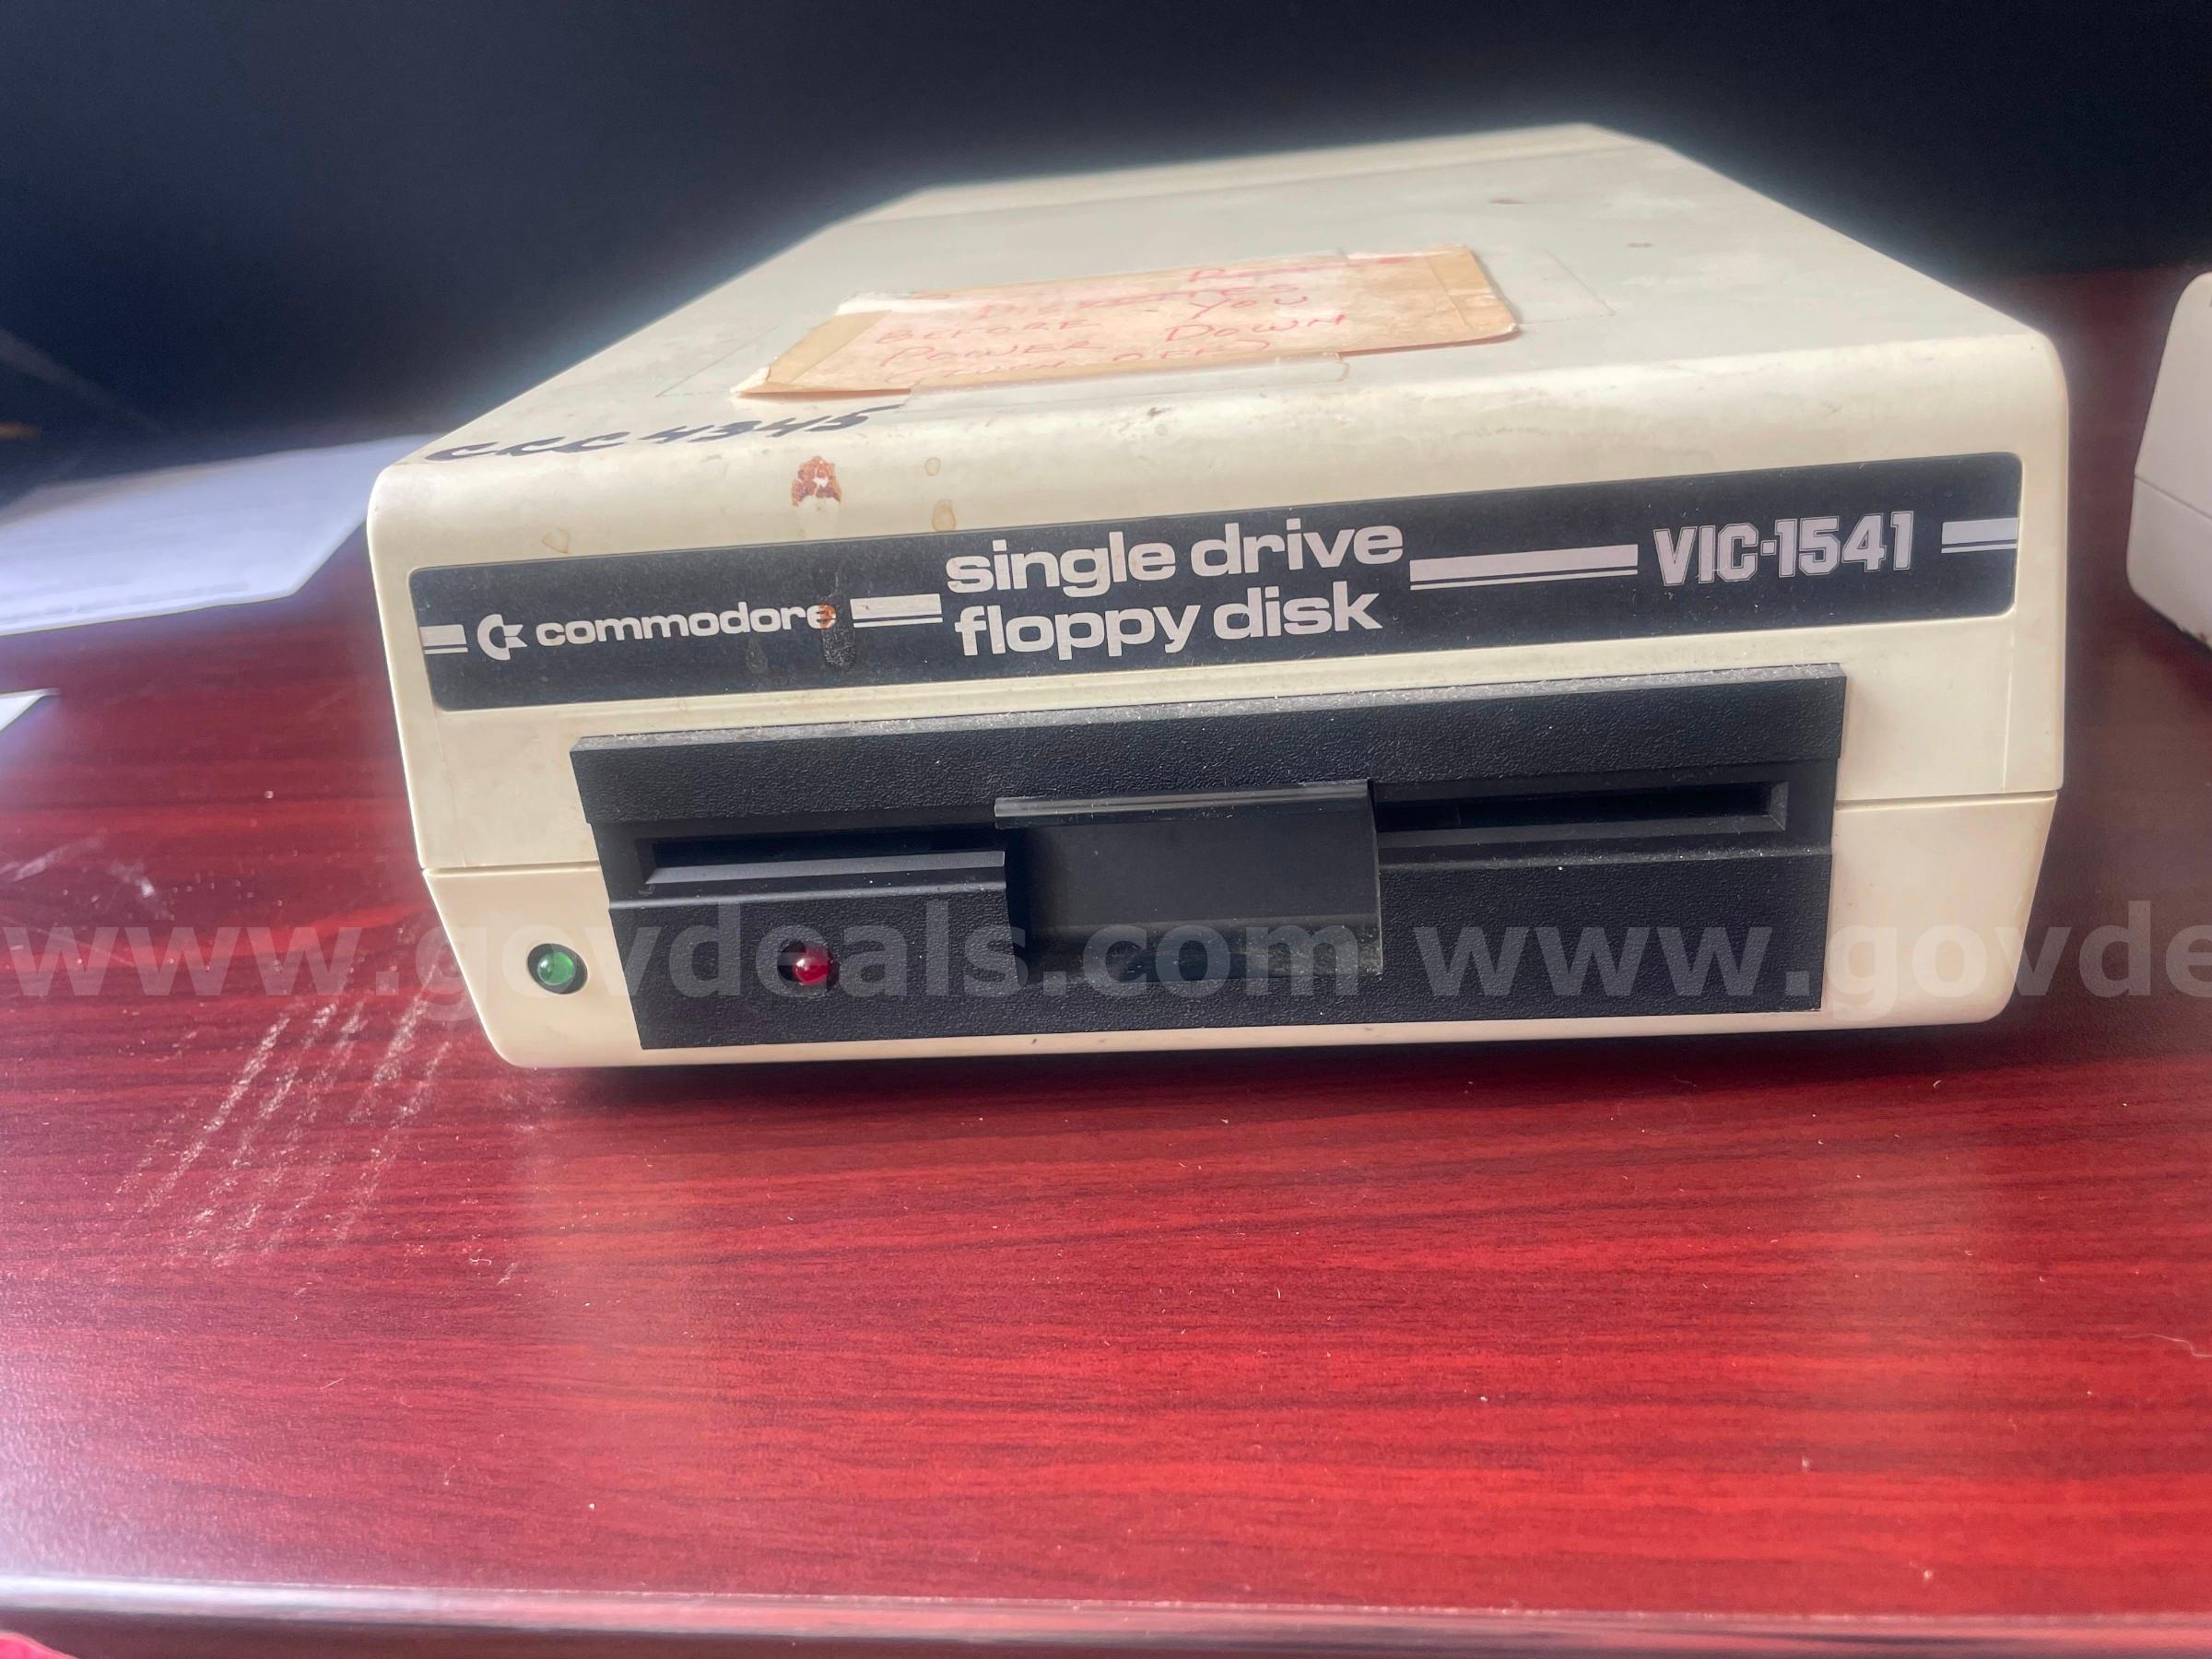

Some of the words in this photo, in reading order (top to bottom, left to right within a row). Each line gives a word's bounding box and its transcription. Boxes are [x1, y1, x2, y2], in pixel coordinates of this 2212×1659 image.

[874, 317, 1102, 345] BEFORE
[1187, 291, 1309, 321] YOU
[878, 339, 1108, 369] POWER
[1163, 313, 1347, 342] DOWN
[946, 531, 1177, 598] single
[1190, 517, 1405, 577] drive
[1653, 510, 1915, 587] VIC-1541
[535, 601, 837, 647] commodore
[954, 603, 1202, 661] floppy
[1212, 581, 1383, 641] disk
